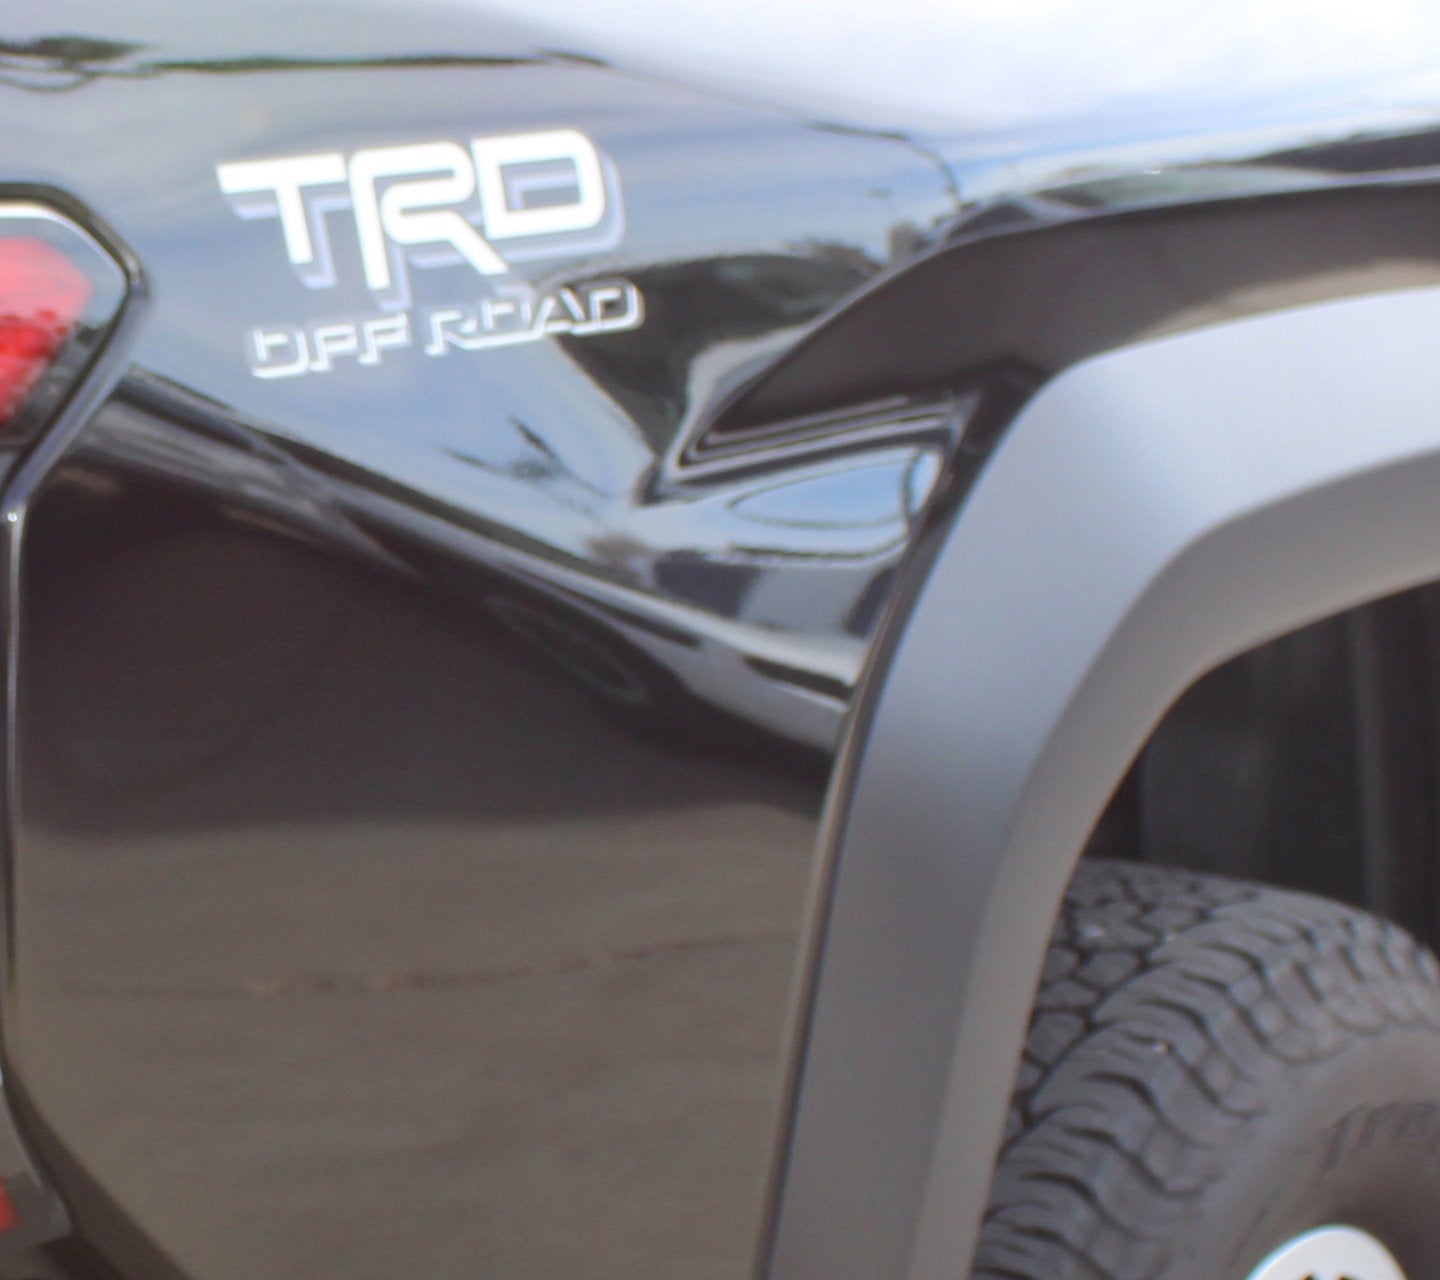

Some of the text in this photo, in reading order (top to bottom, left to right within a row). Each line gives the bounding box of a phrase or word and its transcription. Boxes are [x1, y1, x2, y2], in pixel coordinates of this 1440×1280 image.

[216, 129, 608, 292] TRD
[249, 279, 644, 380] OFF ROAD
